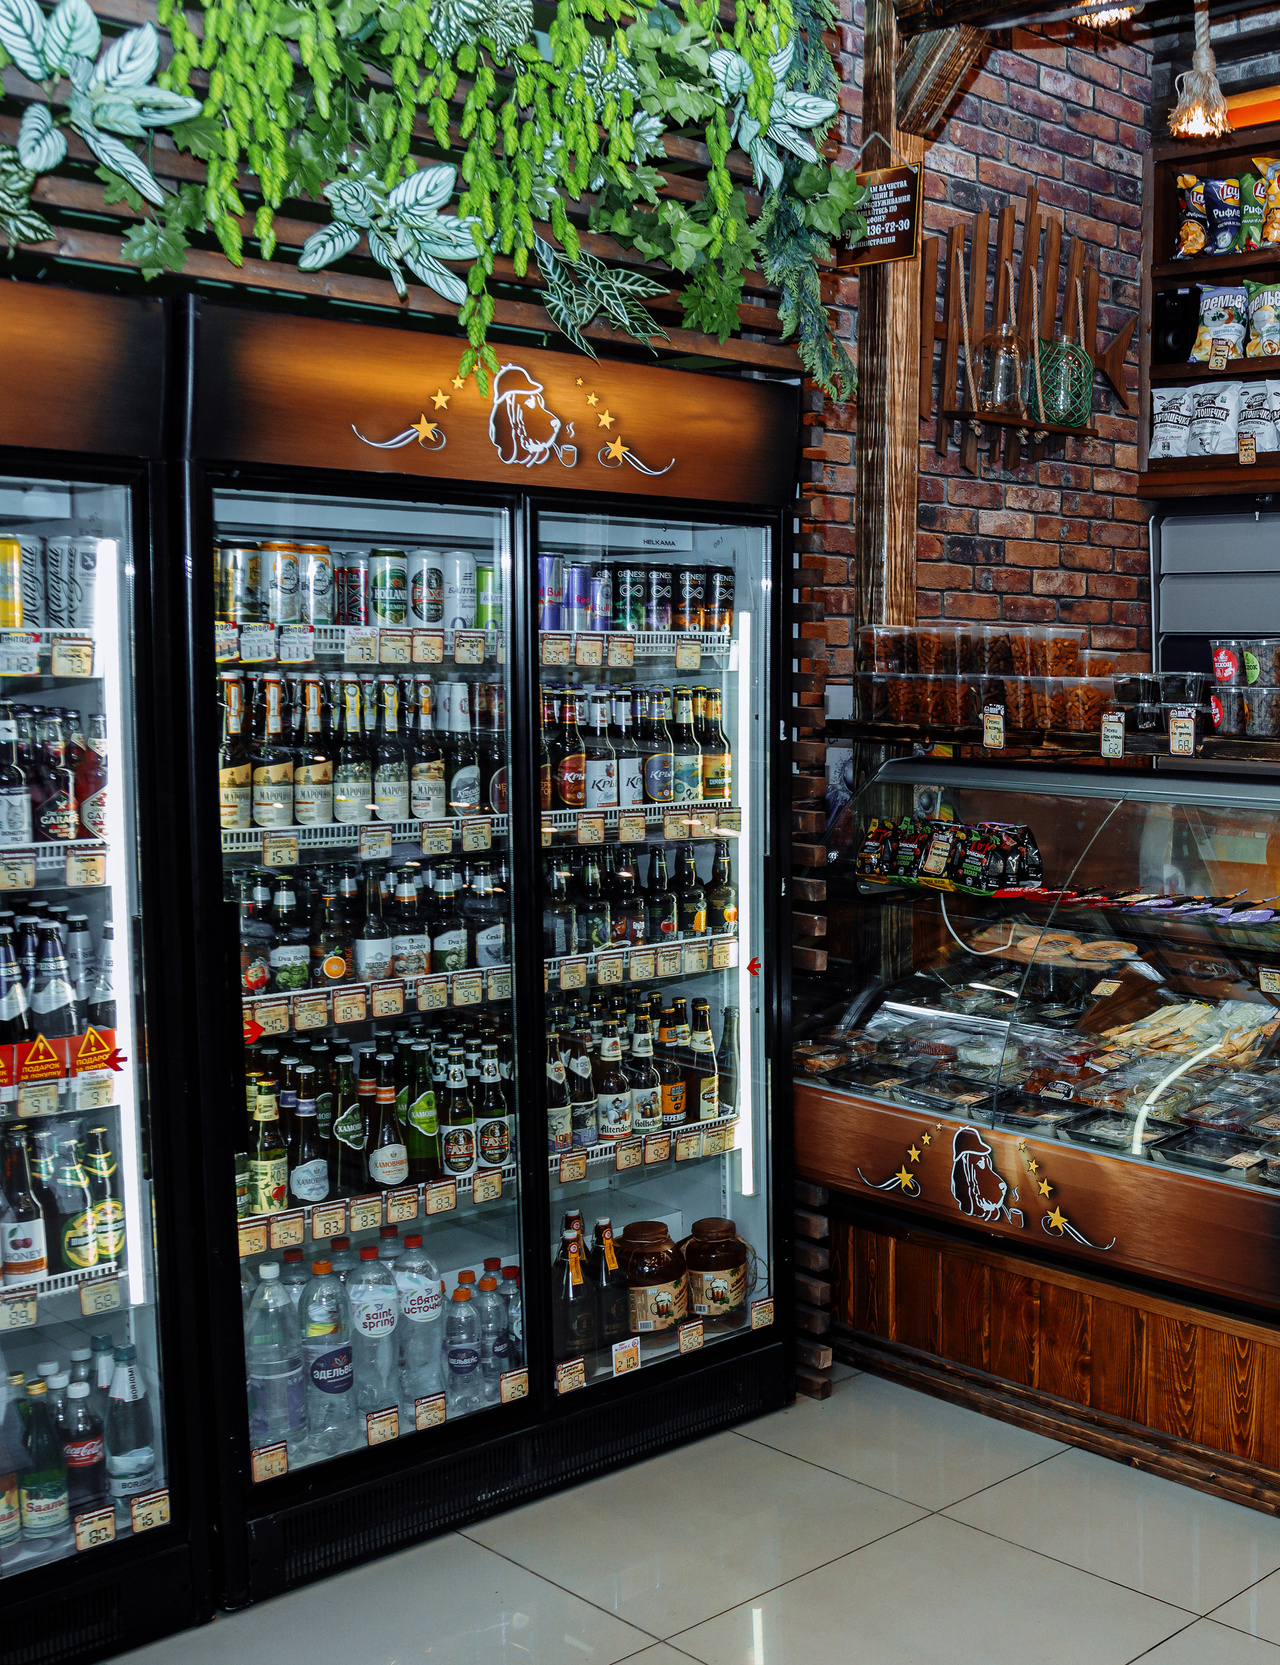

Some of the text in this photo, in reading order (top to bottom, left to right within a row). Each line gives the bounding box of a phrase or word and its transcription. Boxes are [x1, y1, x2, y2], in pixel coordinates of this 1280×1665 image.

[879, 180, 908, 192] КАЧЕСТВА
[643, 539, 676, 547] HELKAMA
[22, 1063, 60, 1073] ПОДАРОК
[30, 1070, 61, 1079] покупку
[3, 1248, 43, 1261] HONEY
[365, 1308, 392, 1321] saint
[362, 1318, 395, 1331] spring
